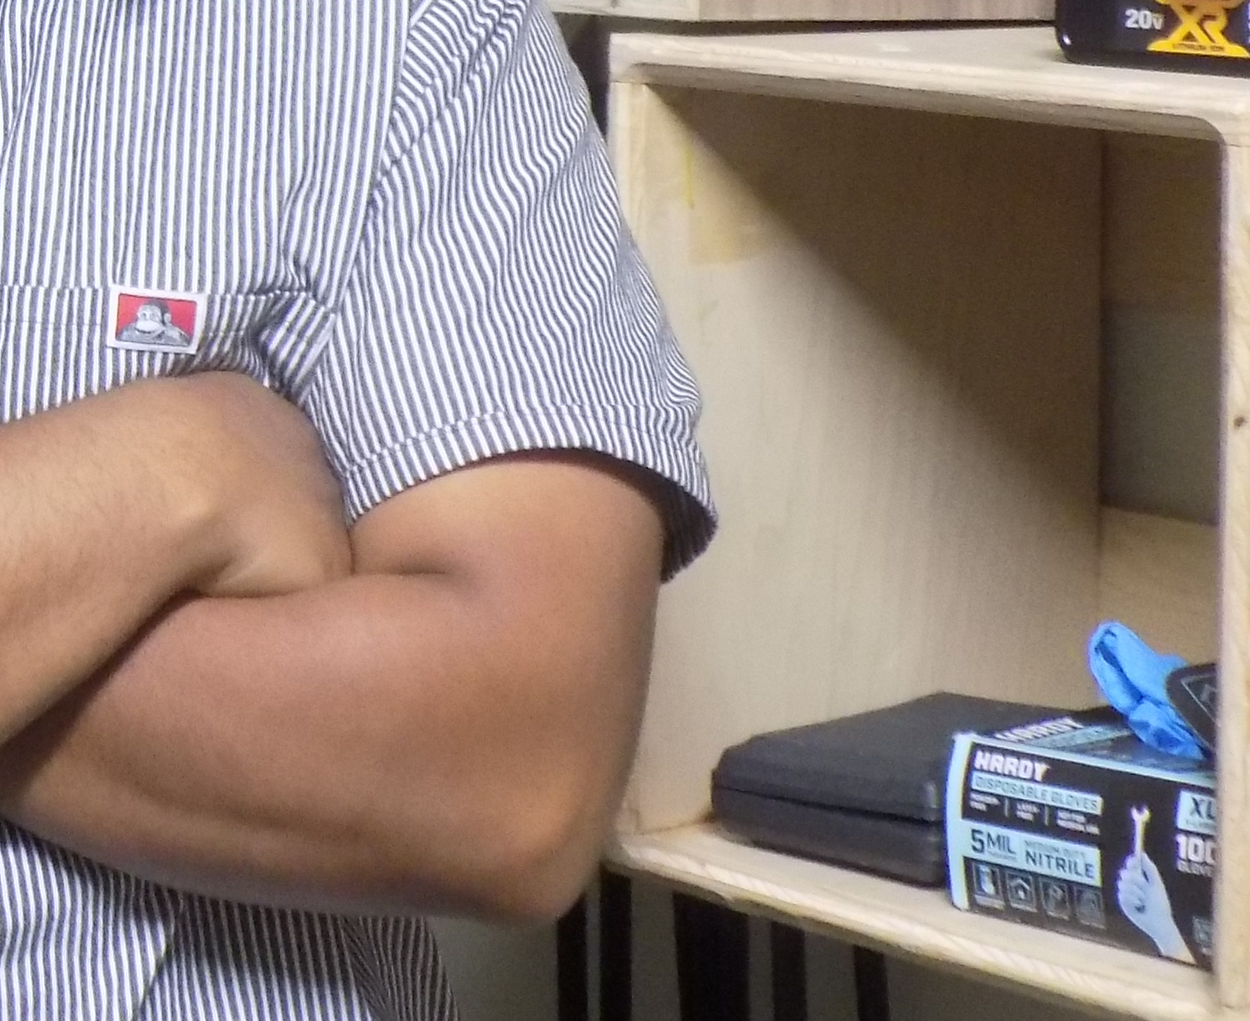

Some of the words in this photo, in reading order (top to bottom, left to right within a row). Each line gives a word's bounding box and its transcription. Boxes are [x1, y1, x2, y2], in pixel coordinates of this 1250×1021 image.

[974, 750, 1050, 782] HARDY
[975, 776, 1049, 797] DISPOSABLE
[1051, 793, 1098, 811] GLOVES
[970, 829, 985, 854] 5
[986, 832, 1017, 855] MIL
[1025, 849, 1096, 879] NITRILE
